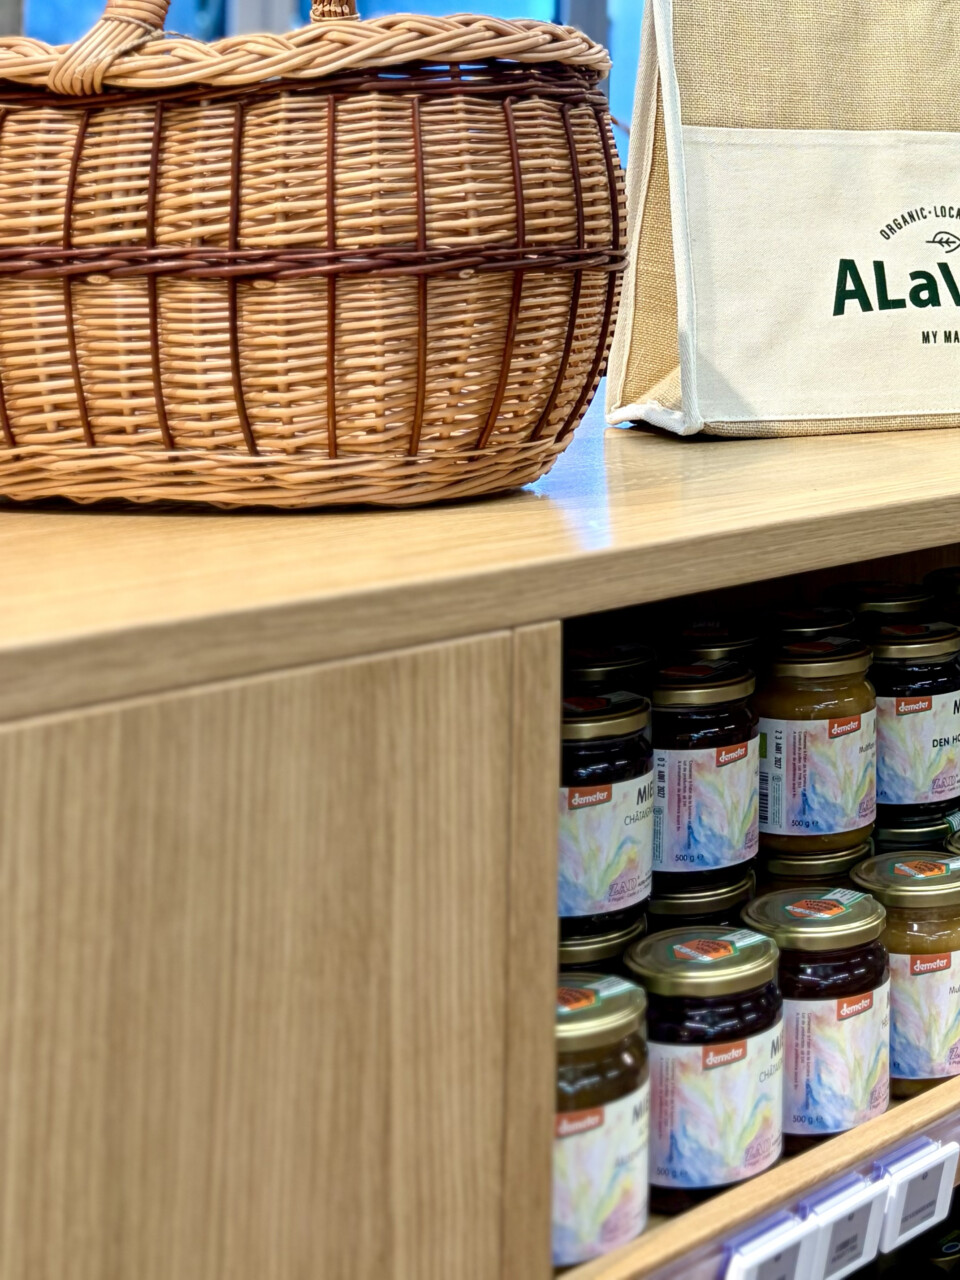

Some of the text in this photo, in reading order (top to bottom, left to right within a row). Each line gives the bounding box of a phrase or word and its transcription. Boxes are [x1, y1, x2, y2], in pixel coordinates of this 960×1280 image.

[921, 330, 938, 344] MY
[899, 700, 929, 713] demeter
[932, 736, 949, 748] DEN
[719, 747, 746, 763] demeter
[571, 790, 608, 806] demeter
[791, 819, 803, 827] 500
[675, 854, 688, 862] 500
[913, 958, 948, 972] demeter
[840, 998, 870, 1016] demeter
[706, 1047, 743, 1065] demeter
[792, 1114, 806, 1123] 500
